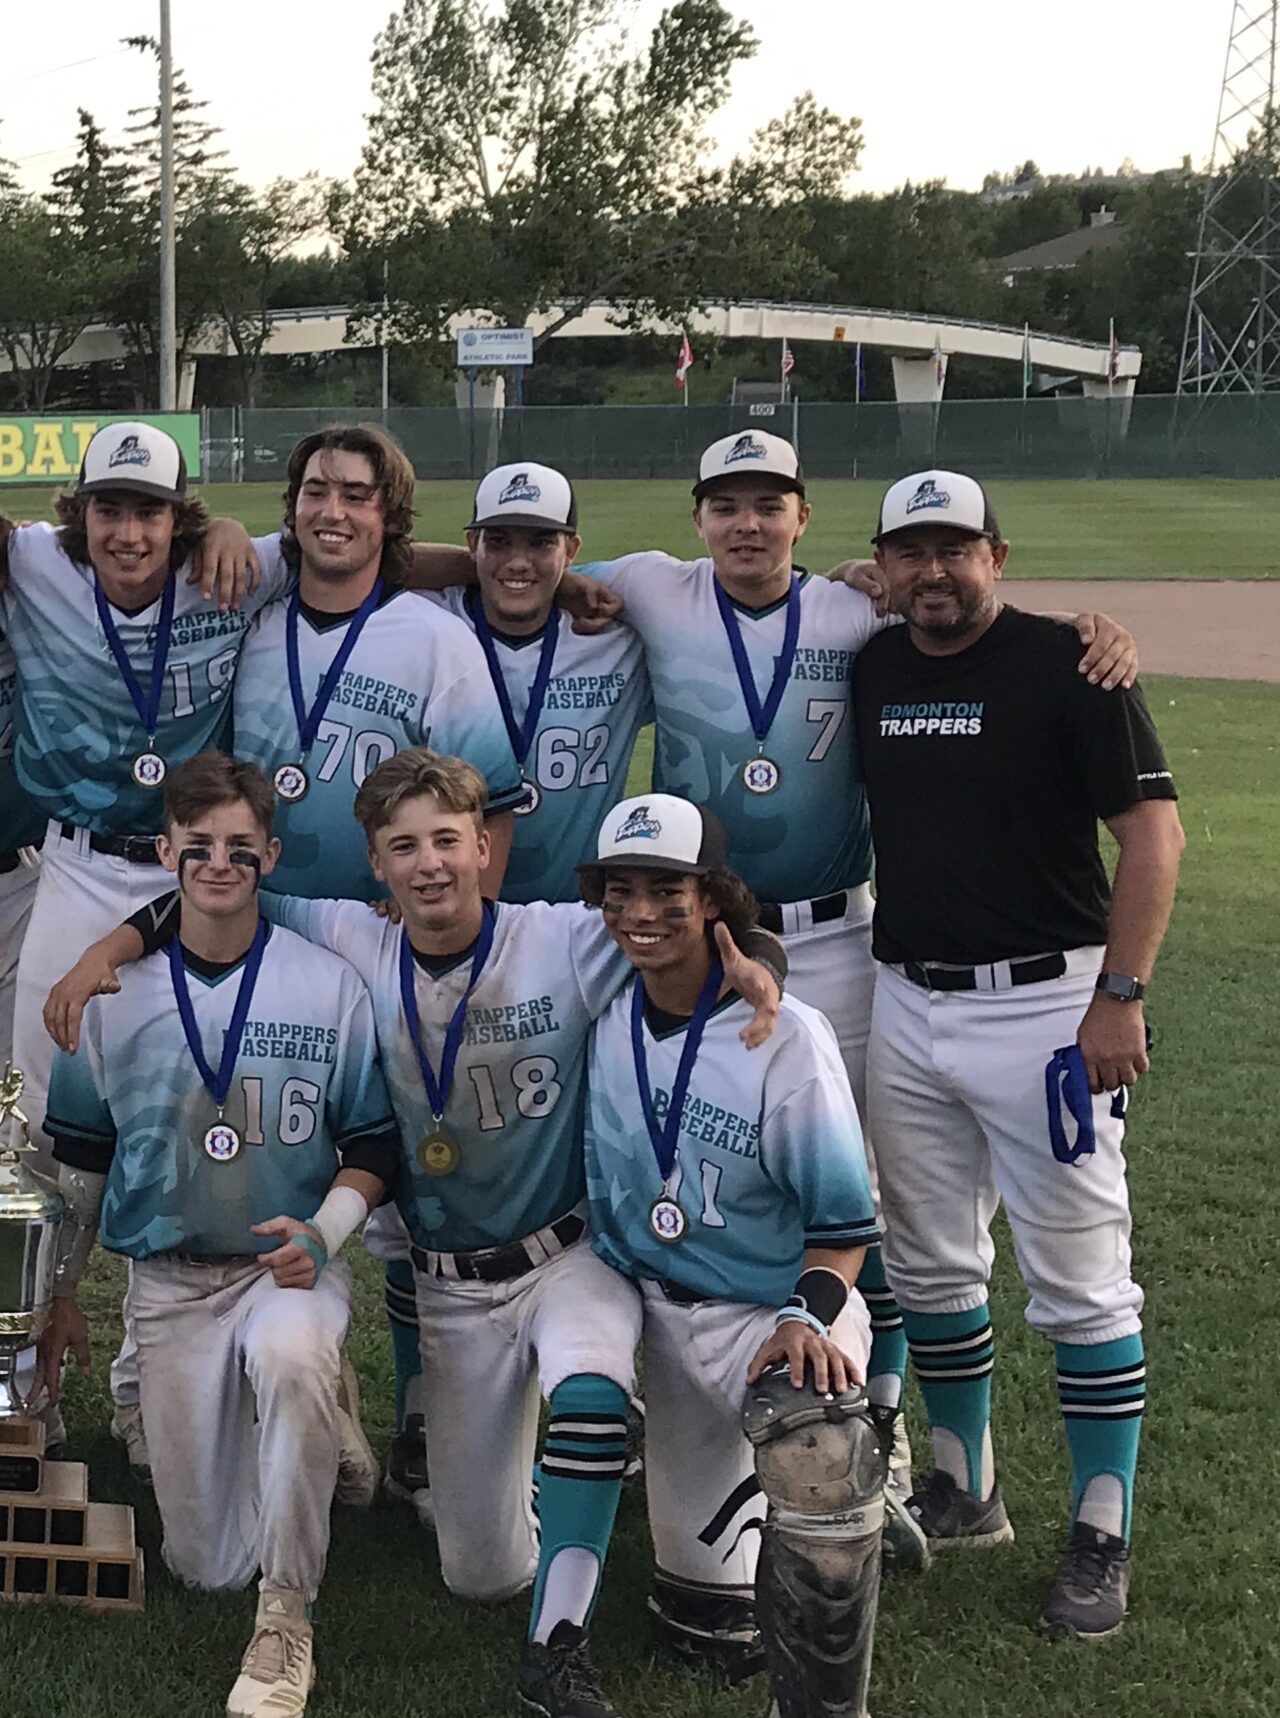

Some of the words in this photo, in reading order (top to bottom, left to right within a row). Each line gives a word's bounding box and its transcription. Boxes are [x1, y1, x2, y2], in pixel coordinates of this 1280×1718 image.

[481, 332, 525, 341] OPTIMIST
[773, 655, 852, 682] ASEB
[795, 648, 857, 665] TRAPP
[170, 647, 238, 718] 19
[315, 672, 411, 722] ASEBALL
[341, 670, 419, 709] RAPPERS
[528, 685, 624, 710] ASEBALL
[547, 672, 626, 692] TRAPPERS
[880, 702, 985, 720] EDMONTON
[880, 718, 982, 737] TRAPPERS
[806, 698, 848, 763] 7
[317, 718, 398, 790] 70
[535, 723, 611, 792] 62
[222, 1028, 334, 1064] ASEBALL
[244, 1021, 338, 1045] TRAPPERS
[462, 1013, 560, 1046] ASEBALL
[241, 1076, 321, 1146] 16
[467, 1054, 564, 1132] 18
[682, 1091, 762, 1140] RAPPERS
